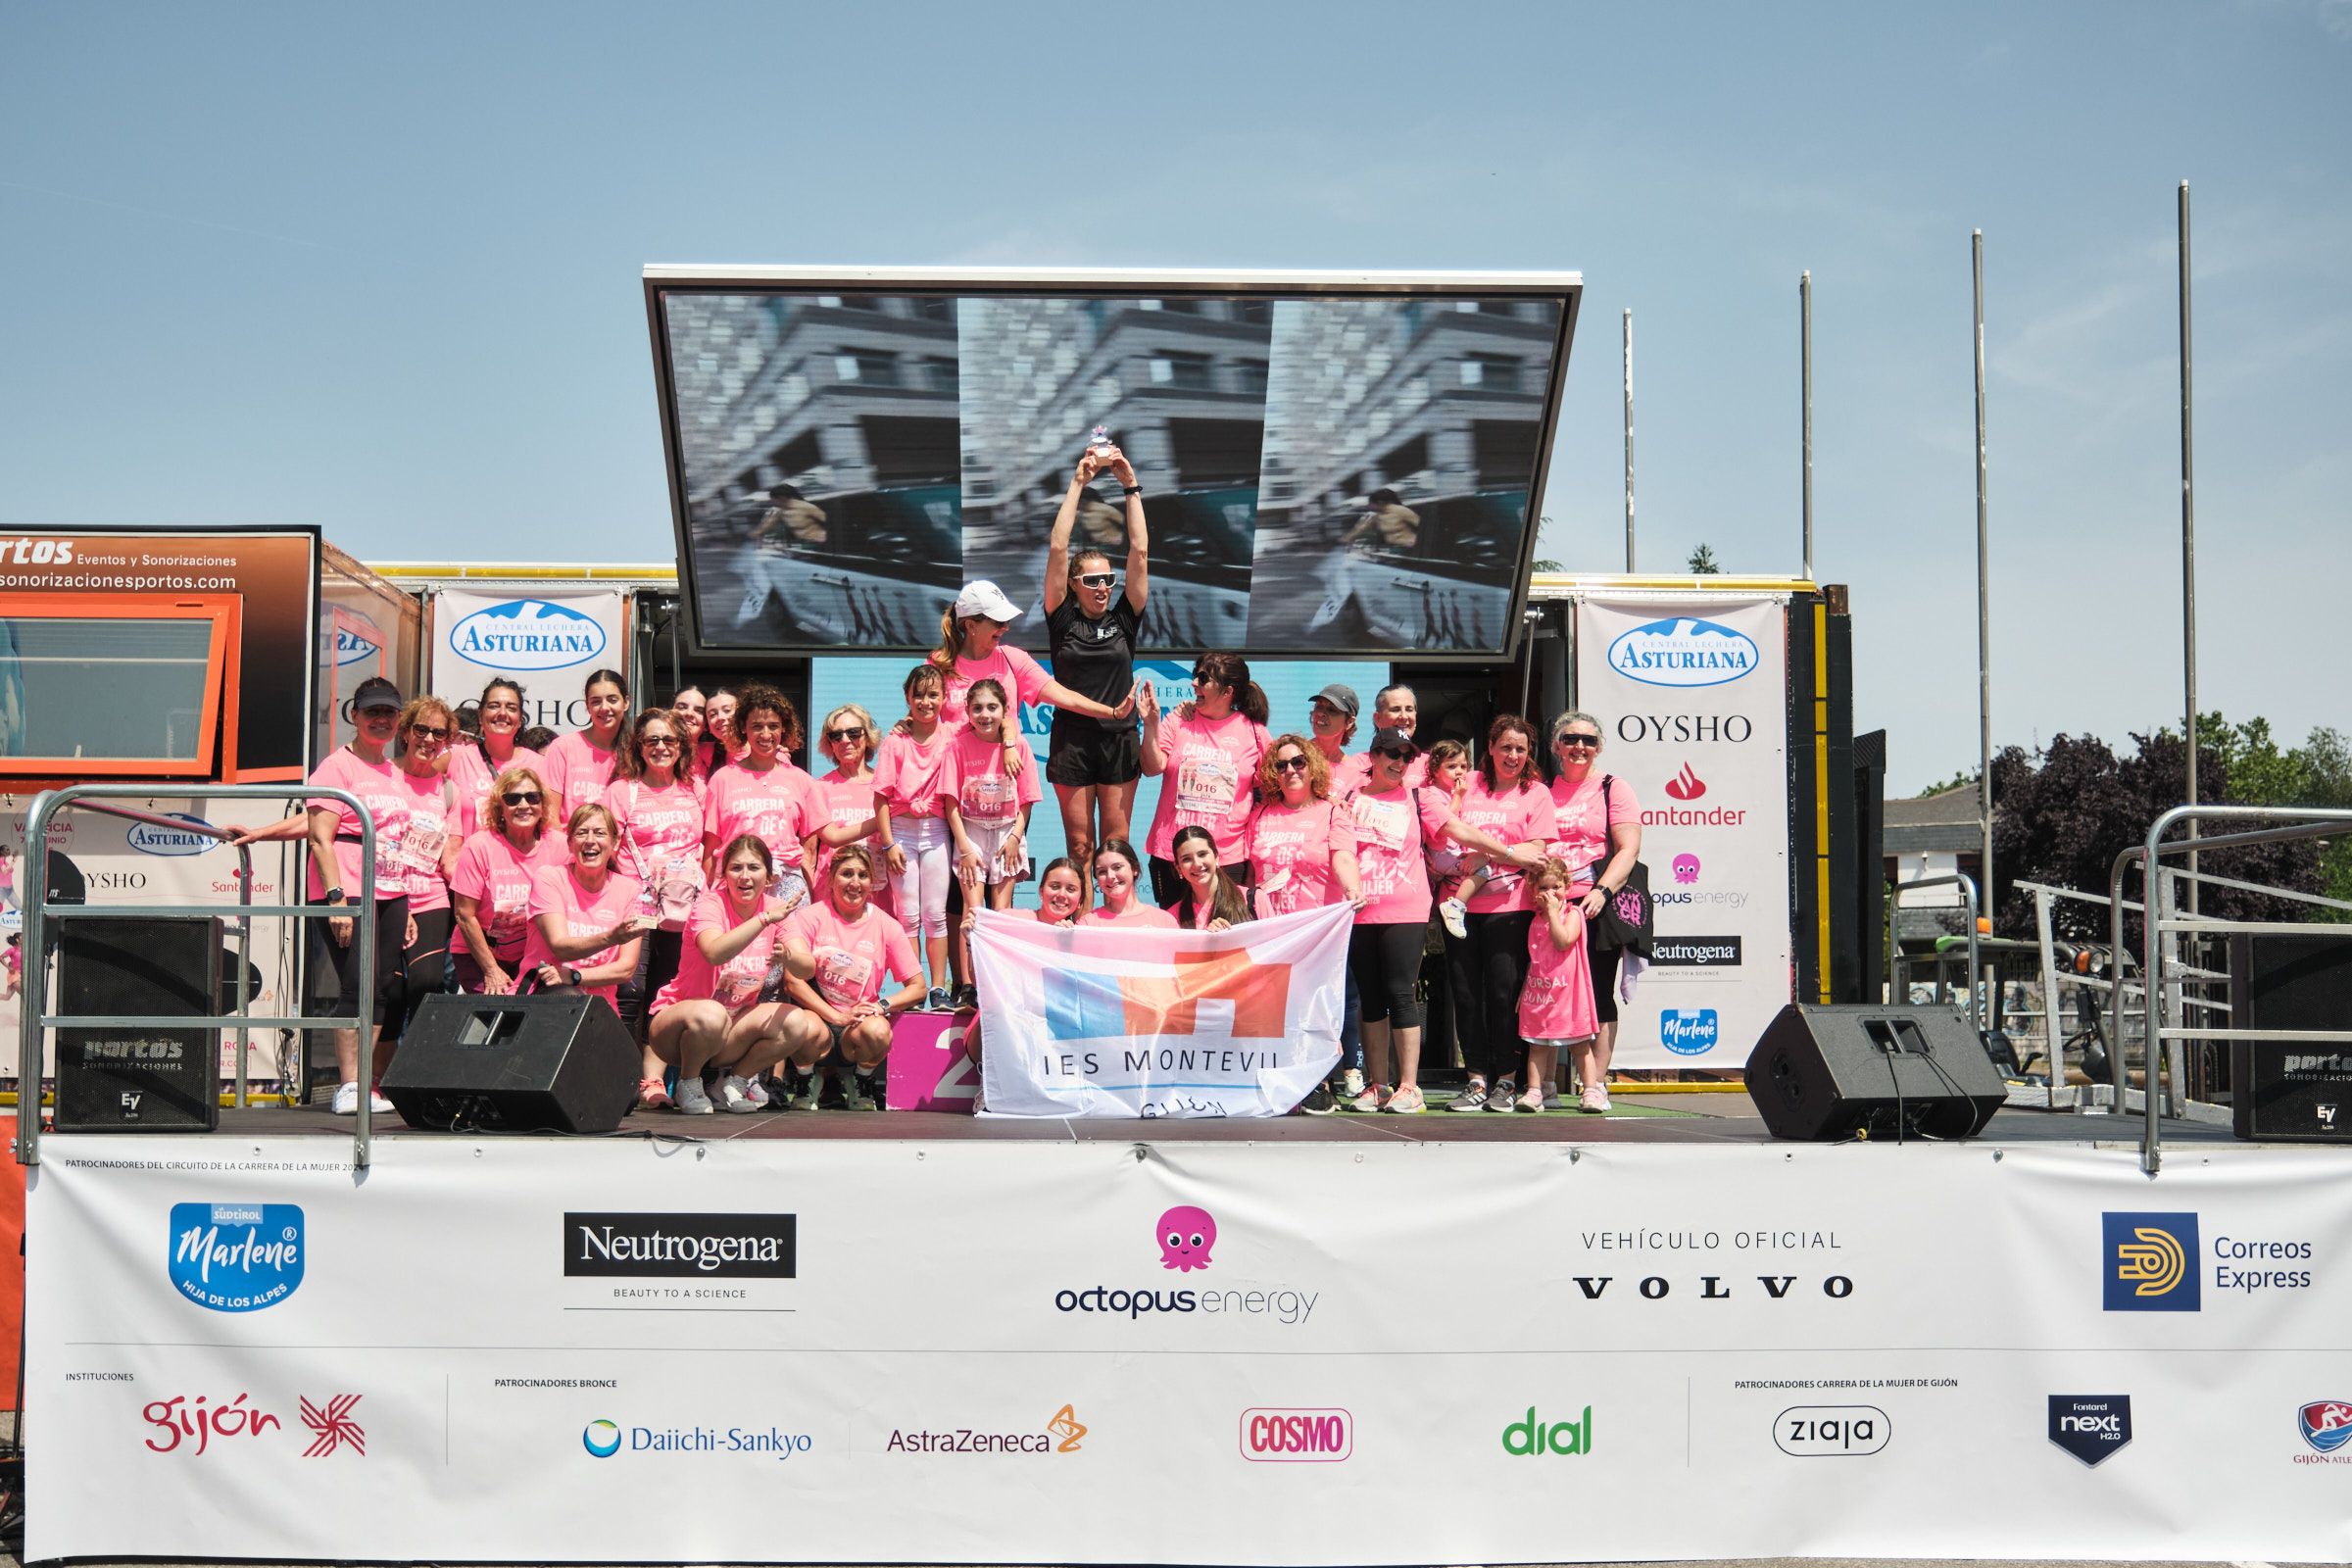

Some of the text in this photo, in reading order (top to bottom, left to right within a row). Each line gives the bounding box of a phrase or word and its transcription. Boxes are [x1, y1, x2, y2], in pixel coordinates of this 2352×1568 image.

[76, 554, 126, 565] Eventos
[130, 557, 138, 567] y
[142, 554, 237, 566] Sonorizaciones
[462, 625, 594, 653] ASTURIANA
[1621, 642, 1748, 668] ASTURIANA
[1618, 714, 1752, 743] OYSHO
[573, 781, 605, 799] CARRE
[1196, 784, 1217, 794] 016
[732, 799, 785, 815] CARRERA
[980, 803, 1002, 811] 016
[637, 810, 694, 828] CARRERA
[1641, 807, 1746, 826] antander
[134, 828, 214, 846] ASTURIANA
[86, 872, 147, 889] YSHO
[212, 881, 274, 893] Santnder
[1362, 880, 1394, 895] UJER
[496, 884, 532, 901] CARR
[1651, 891, 1748, 909] opus energy
[824, 971, 847, 986] 016
[1664, 1019, 1715, 1045] Marlene
[224, 1042, 257, 1052] ROA
[1045, 1053, 1100, 1075] IES
[66, 1159, 145, 1170] PATROCINADORES
[147, 1161, 164, 1170] DEL
[166, 1161, 209, 1171] CIRCUITO
[210, 1162, 223, 1171] DE
[224, 1162, 236, 1171] LA
[238, 1162, 280, 1172] CARRERA
[281, 1163, 294, 1172] DE
[296, 1163, 308, 1172] LA
[310, 1163, 340, 1172] MUJER
[1581, 1227, 1842, 1250] VEHÍCULO OFICIAL
[176, 1225, 298, 1284] Marlene
[579, 1226, 781, 1270] Neutrogena
[2215, 1236, 2312, 1260] Correos
[1572, 1275, 1853, 1299] VOLVO
[2216, 1265, 2311, 1294] Express
[182, 1280, 288, 1308] HIJA DE LOS ALPES
[613, 1289, 747, 1299] BEAUTY TO A SCIENCE
[1054, 1285, 1319, 1324] octopus energy
[65, 1372, 134, 1382] INSTITUCIONES
[494, 1379, 617, 1389] PATROCINADORES BRONCE
[1735, 1376, 1958, 1389] PATROCINADORES CARRERA DE LA MUJER DE GIJÓN
[2073, 1402, 2108, 1411] Fontarel
[142, 1393, 281, 1456] gijón
[1501, 1404, 1592, 1456] dial
[2060, 1415, 2121, 1432] next
[887, 1428, 1050, 1453] AstraZeneca
[1250, 1415, 1344, 1453] COSMO
[1790, 1418, 1874, 1448] ziaja
[631, 1426, 812, 1460] Daiichi-Sankyo
[2293, 1452, 2329, 1465] GIJÓN
